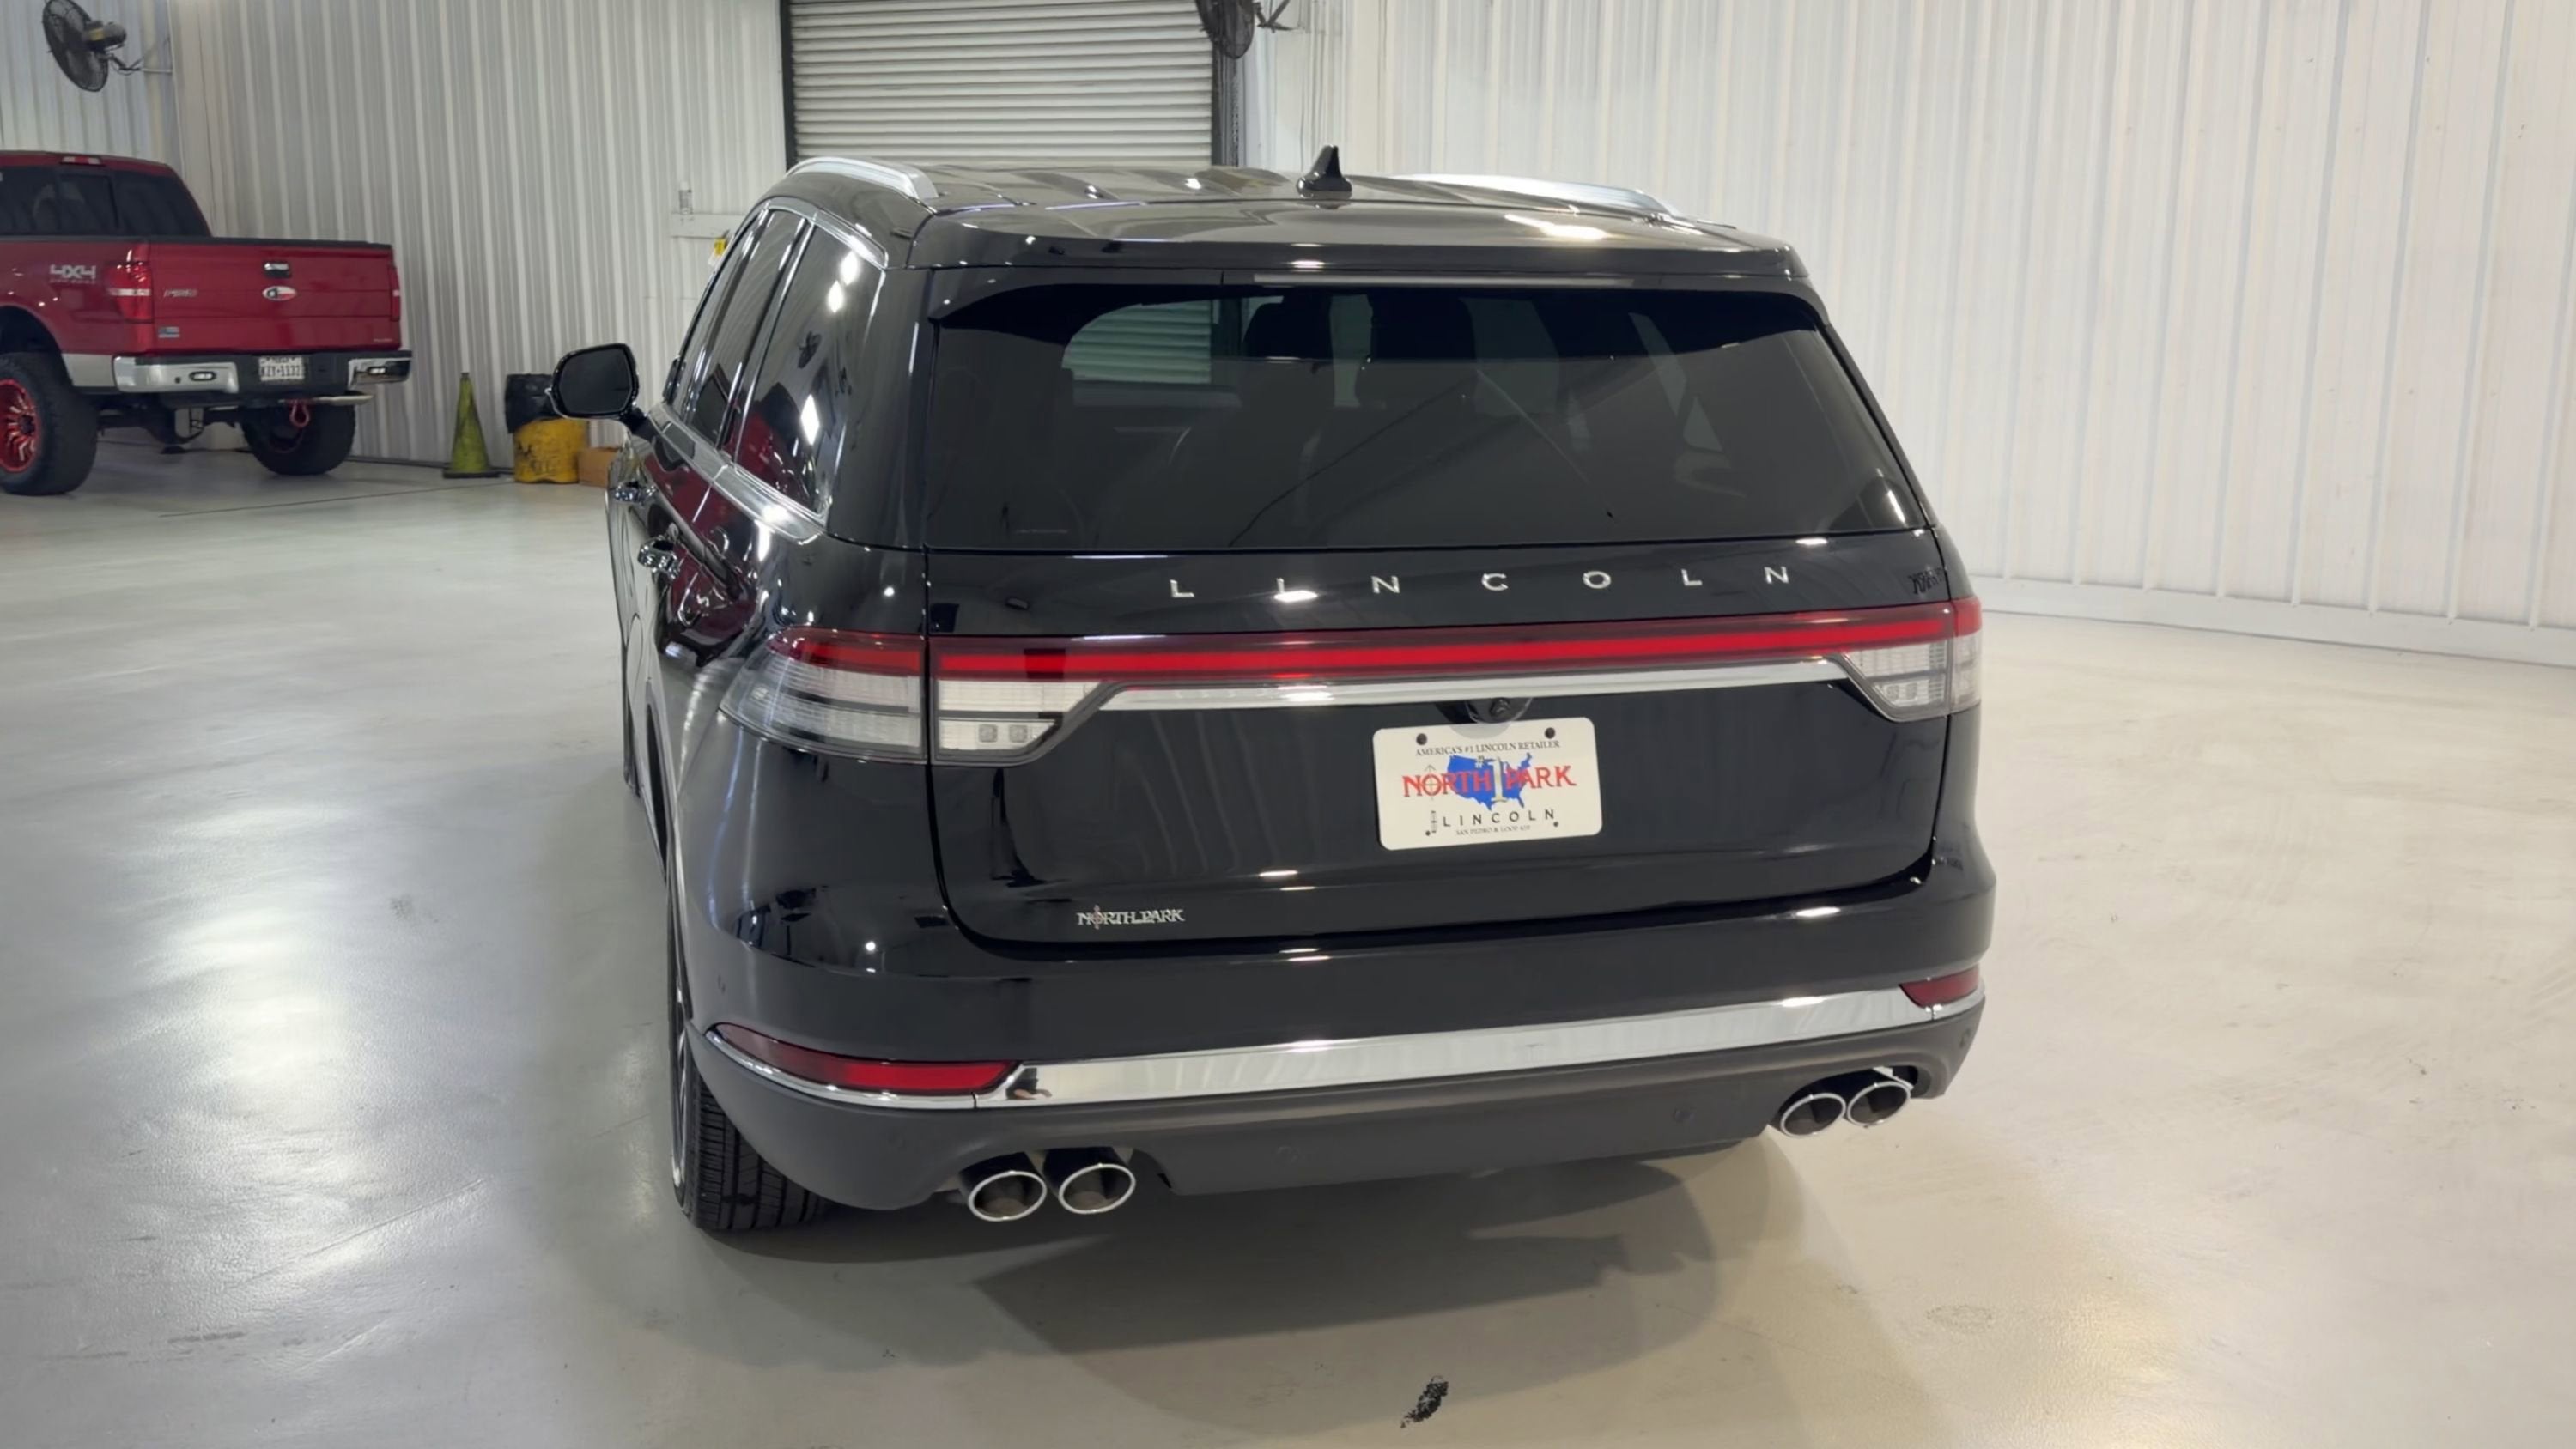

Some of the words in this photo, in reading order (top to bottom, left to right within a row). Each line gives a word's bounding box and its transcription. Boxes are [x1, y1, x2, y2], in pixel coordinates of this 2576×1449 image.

[1170, 566, 1789, 602] LINCOLN
[1416, 746, 1462, 756] AMERICA'S
[1476, 743, 1516, 753] LINCOLN
[1518, 740, 1560, 749] RETAILER
[1402, 769, 1492, 797] NORTH
[1505, 765, 1577, 790] PARK
[1443, 809, 1554, 827] LINCOLN
[1076, 908, 1135, 927] NORTH
[1139, 908, 1186, 925] PARK
